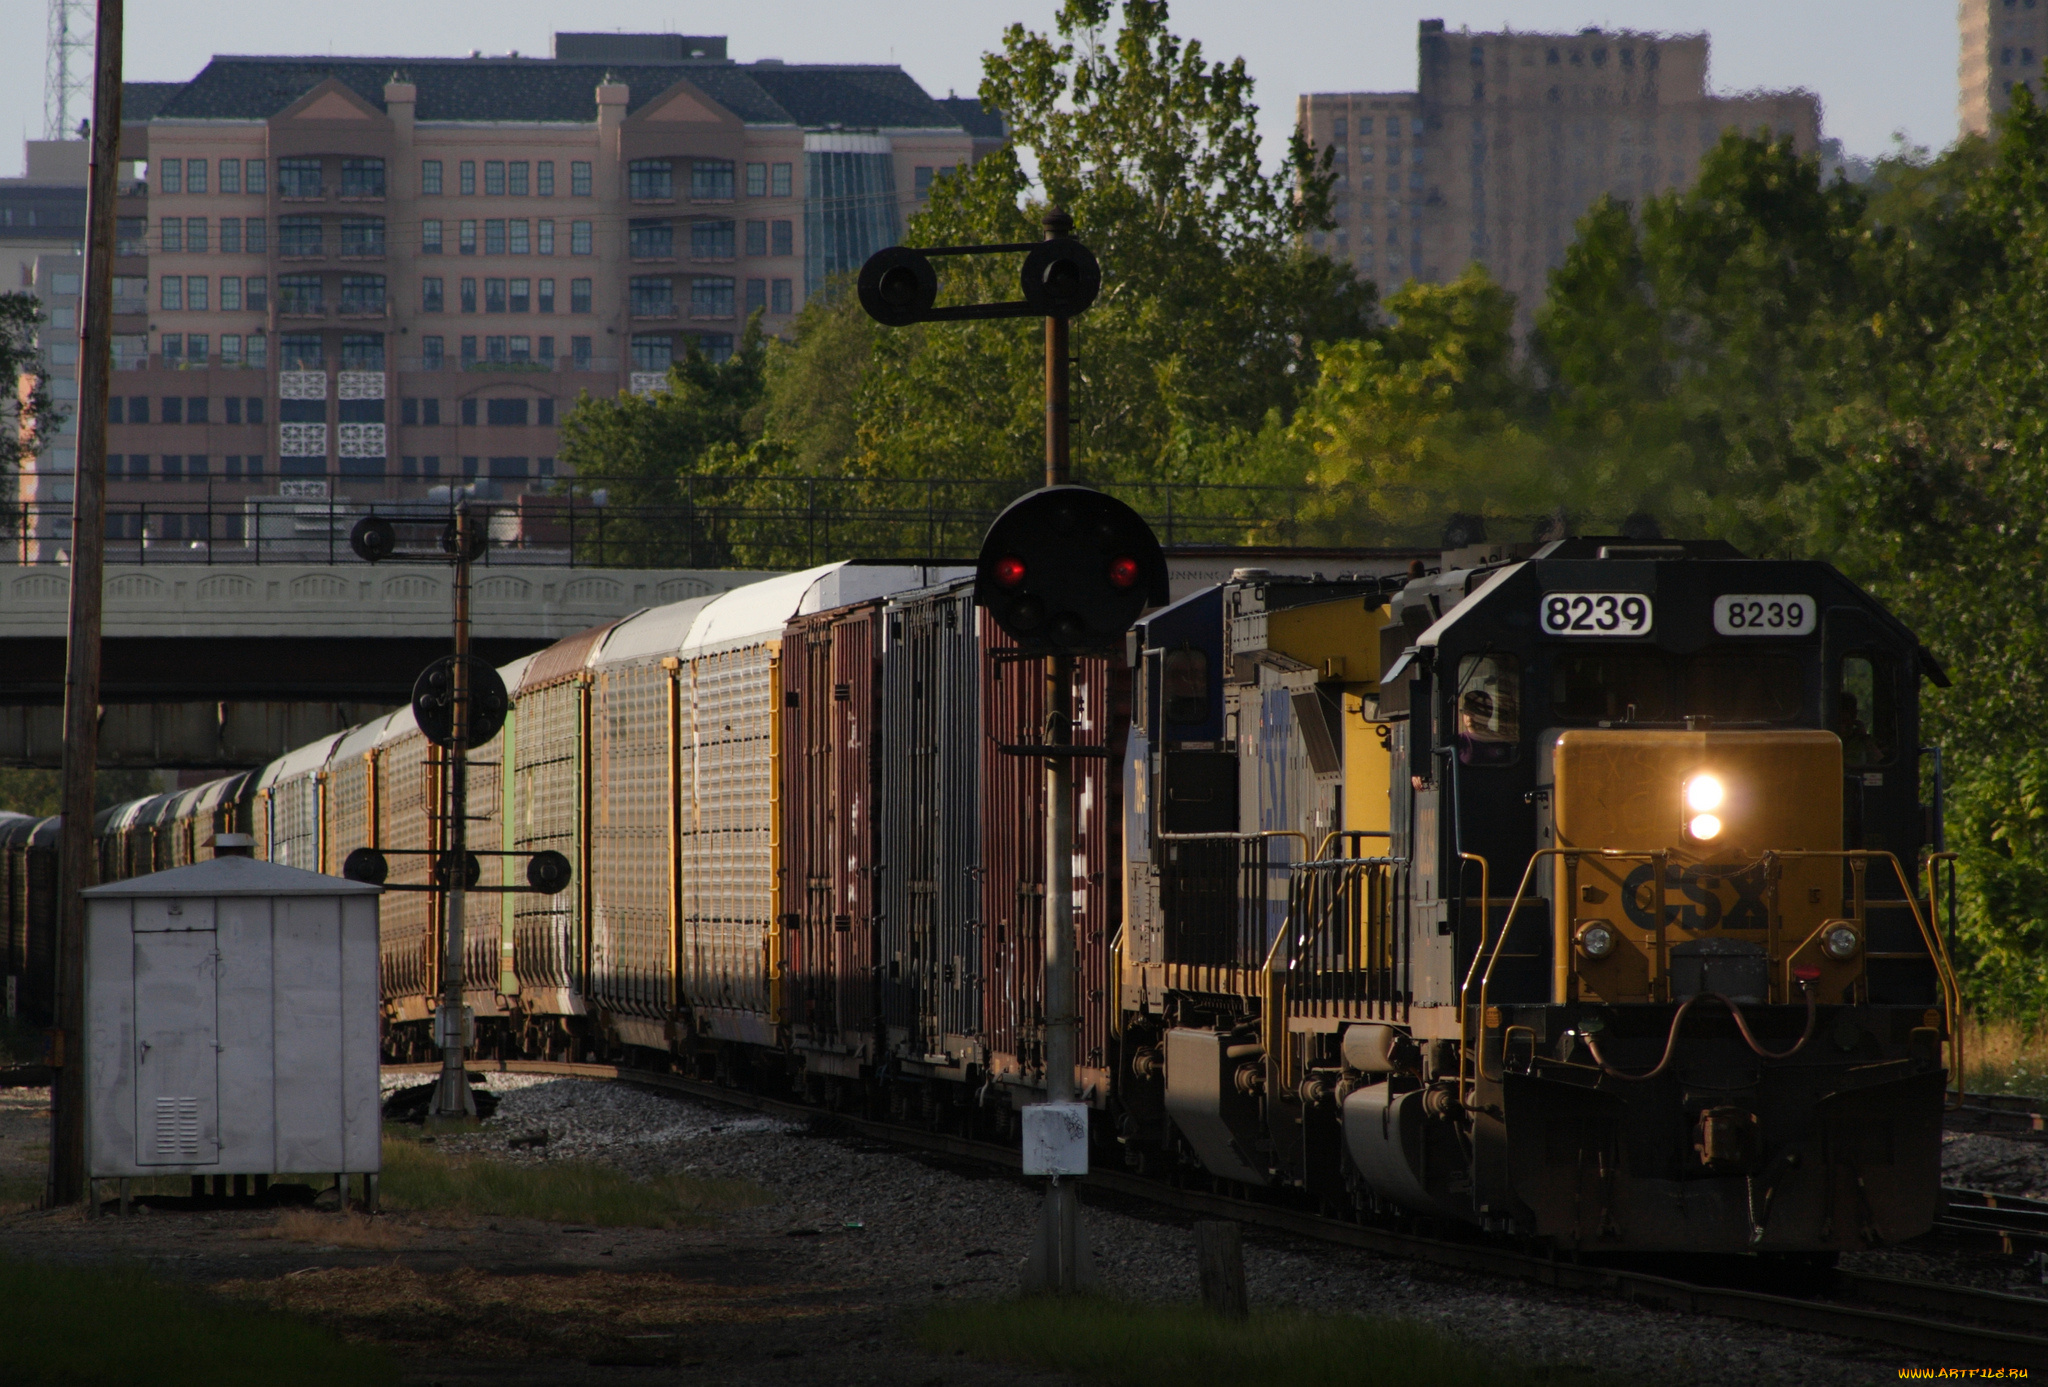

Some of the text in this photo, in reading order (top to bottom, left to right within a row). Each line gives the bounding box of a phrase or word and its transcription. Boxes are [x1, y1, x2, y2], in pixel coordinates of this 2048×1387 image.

[1546, 596, 1646, 631] 8239
[1728, 602, 1804, 628] 8239
[1622, 863, 1782, 930] CSX
